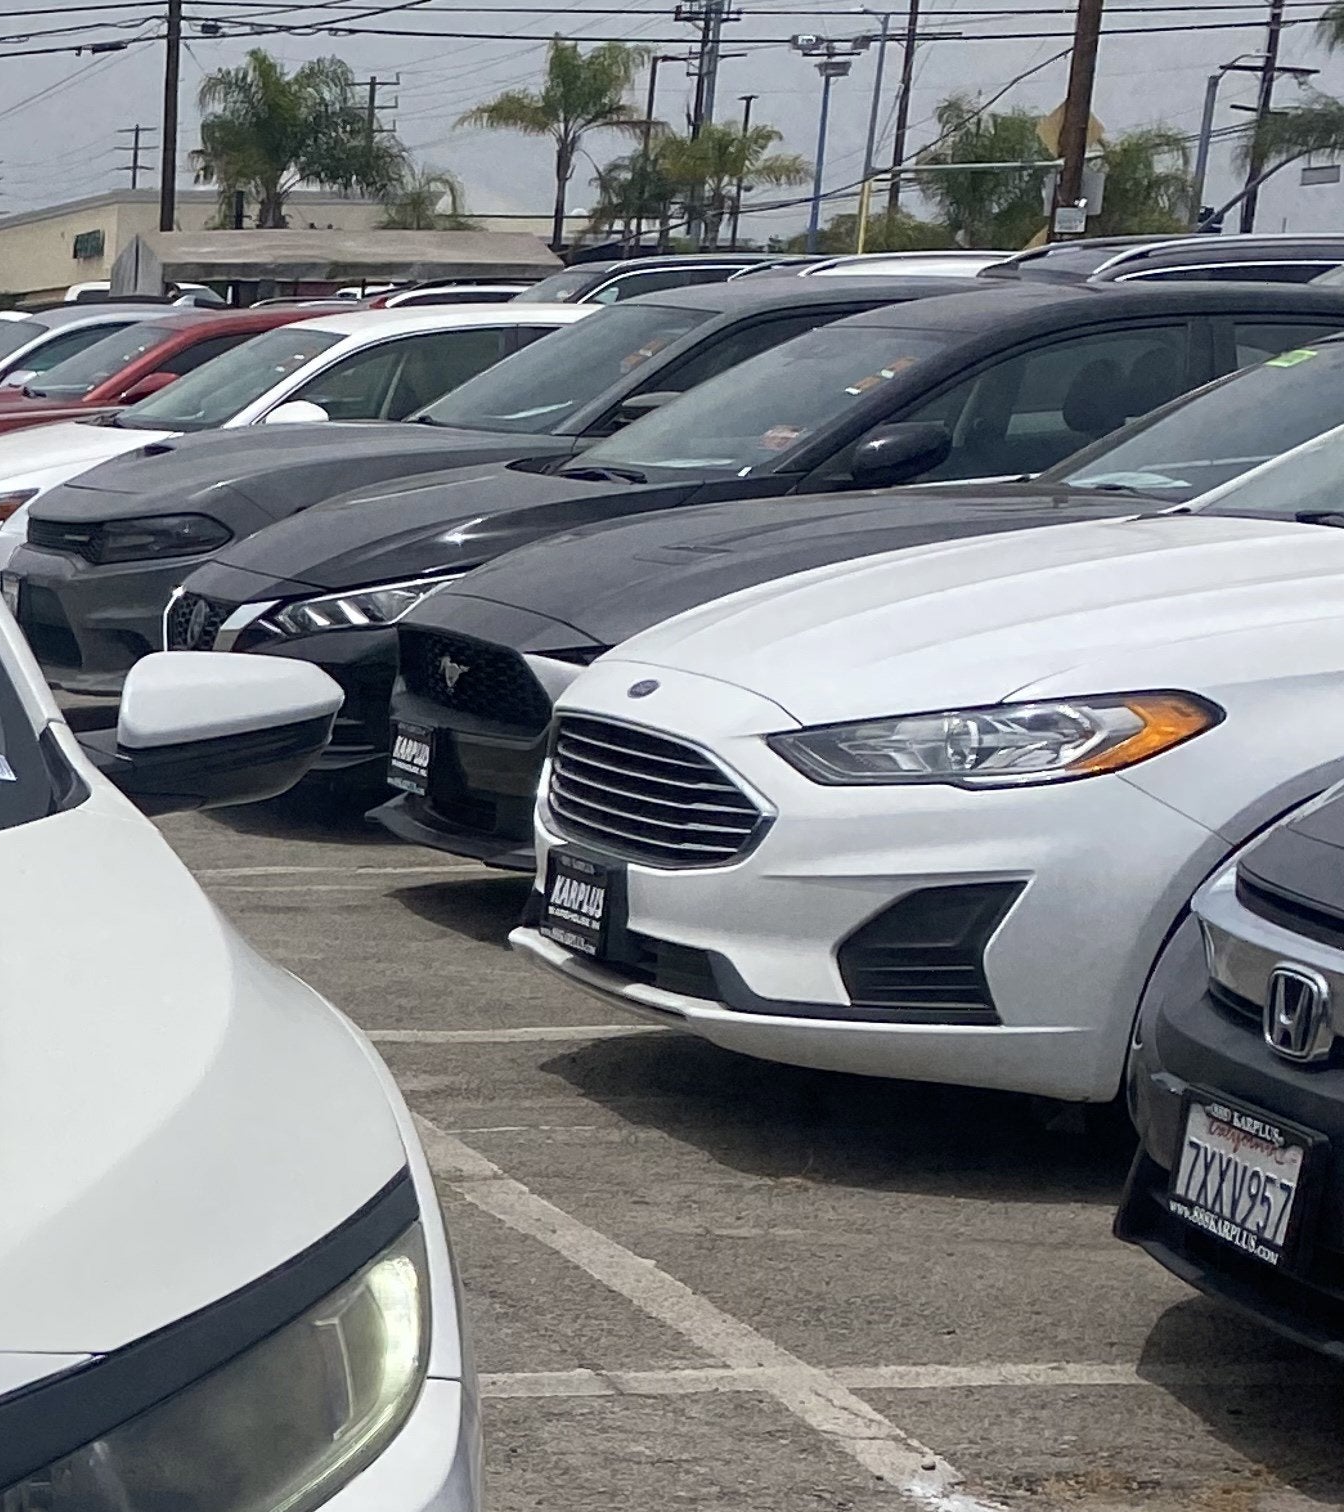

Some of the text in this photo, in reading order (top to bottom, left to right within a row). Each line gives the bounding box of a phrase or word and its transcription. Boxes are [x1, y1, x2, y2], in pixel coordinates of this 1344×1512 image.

[550, 874, 606, 919] KARPLUS
[1232, 1110, 1281, 1144] KARPLUS
[1184, 1139, 1294, 1244] 7XXV957
